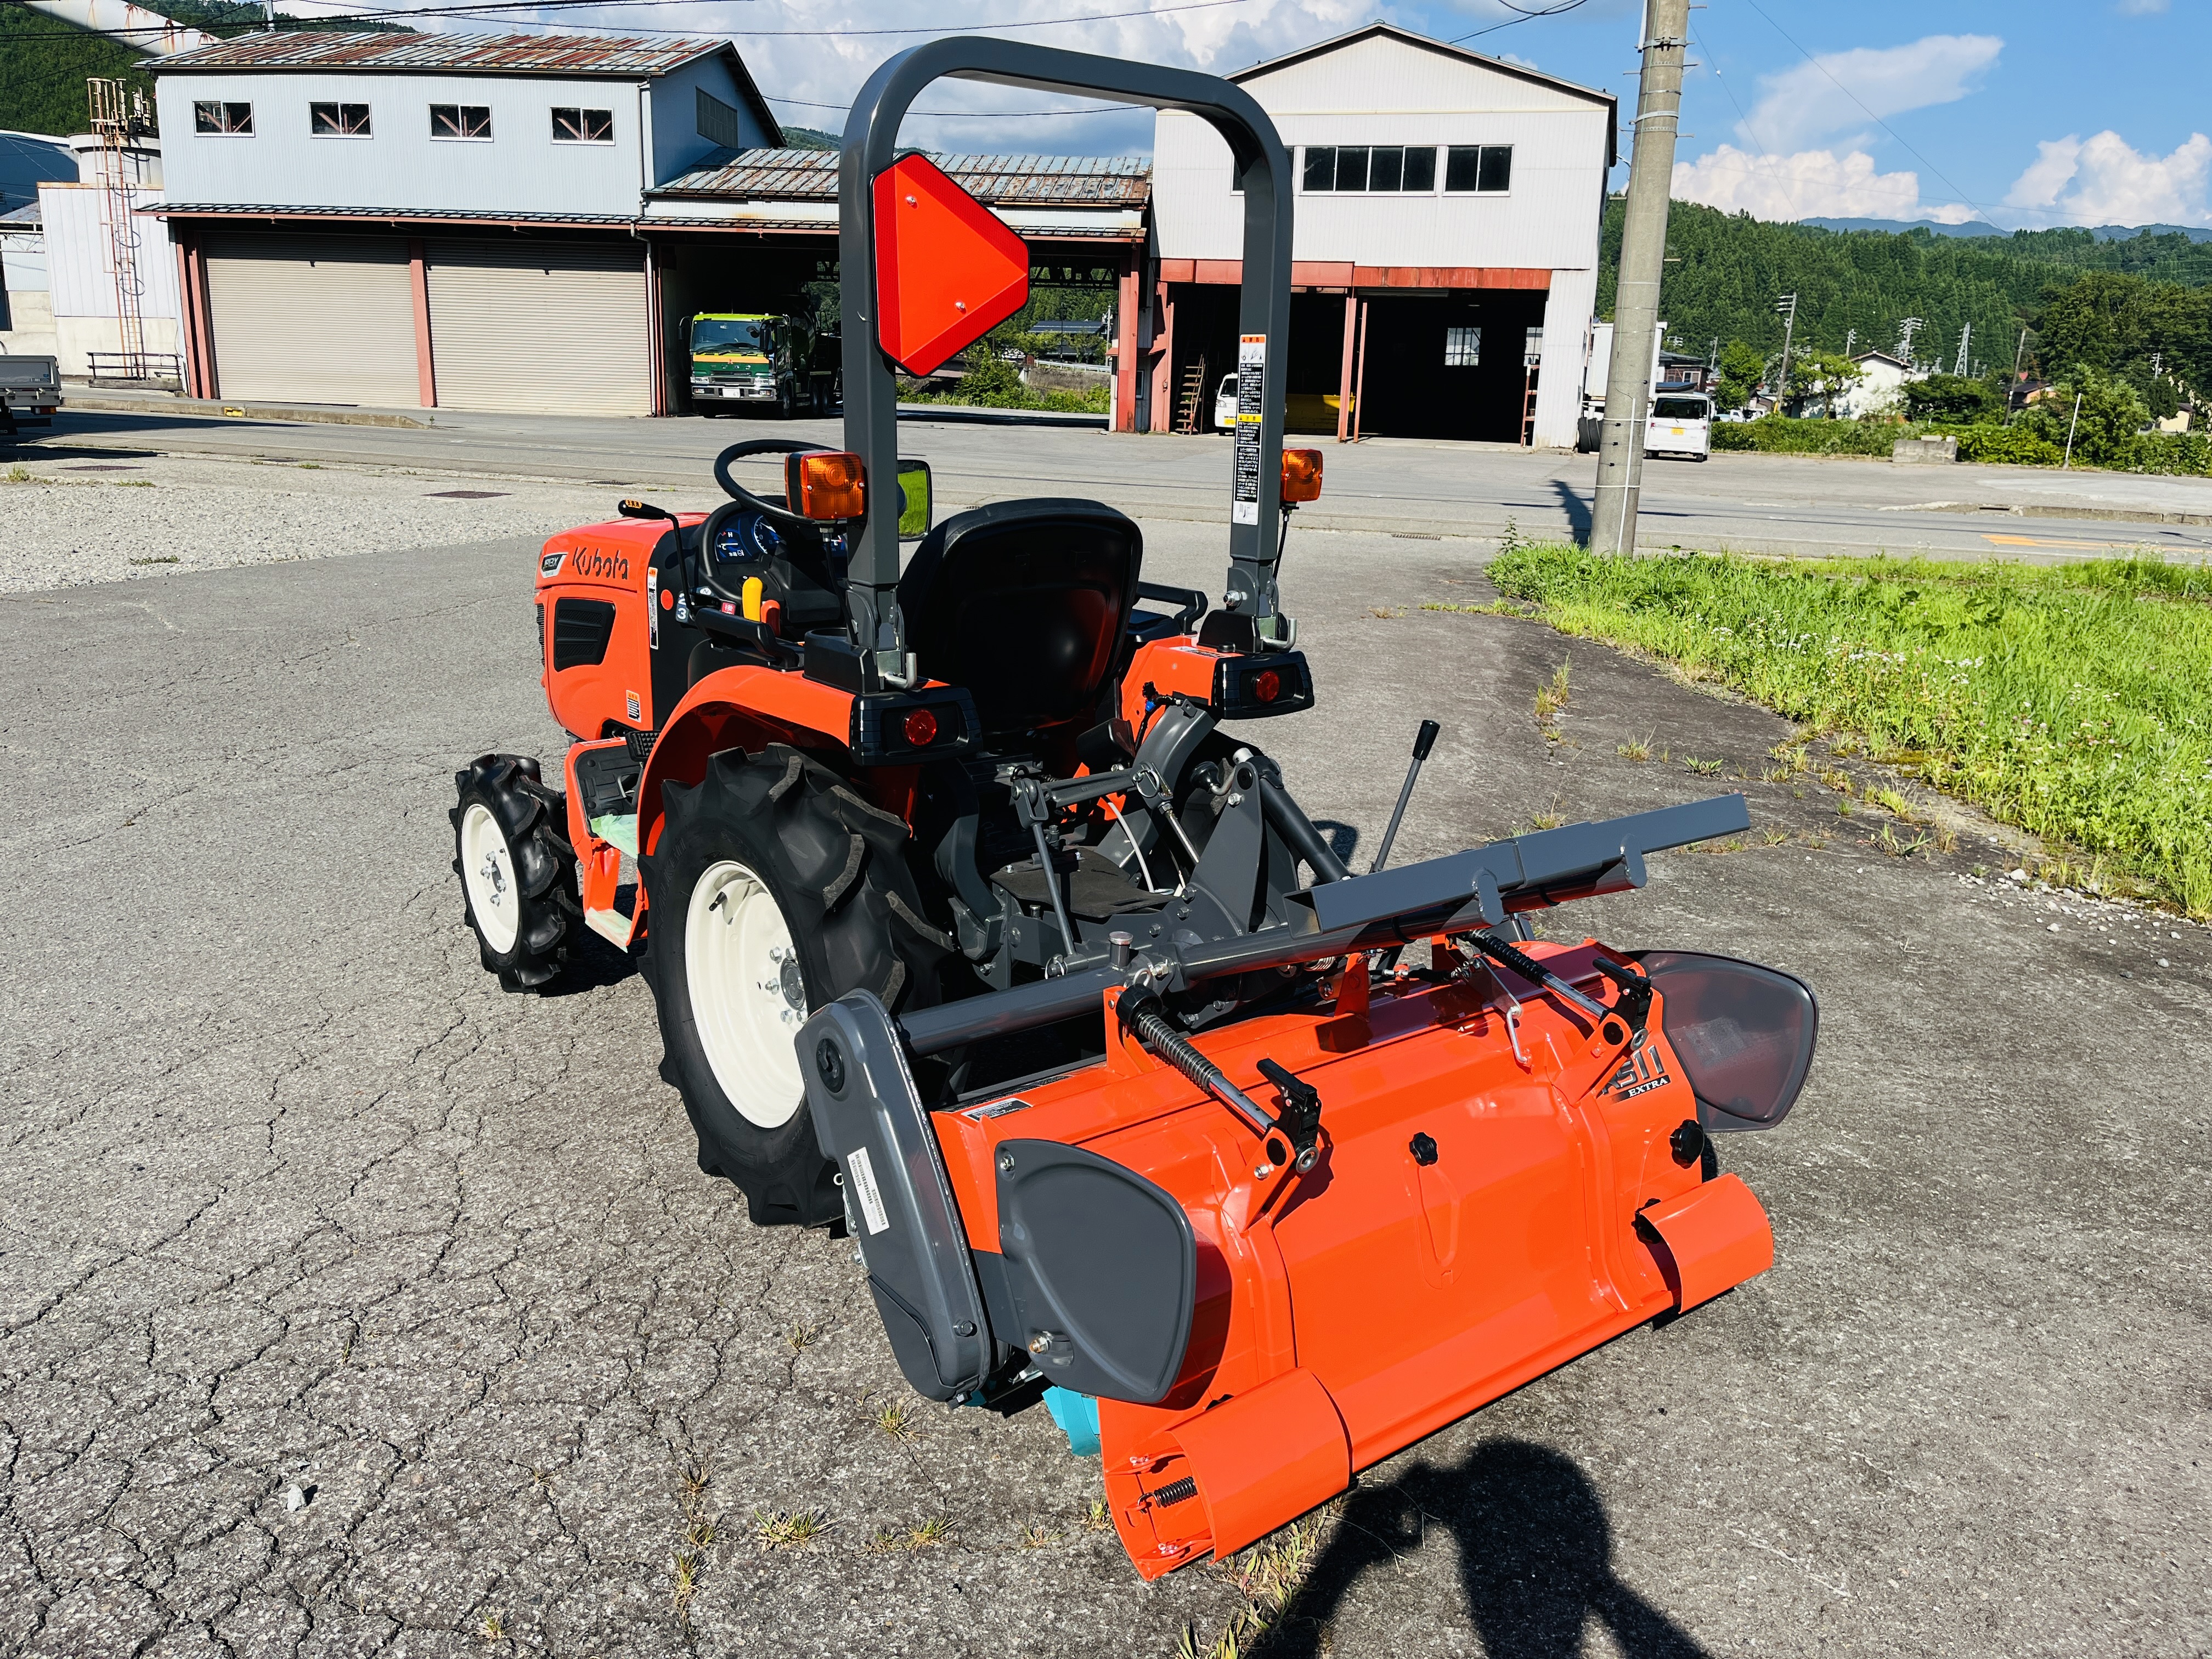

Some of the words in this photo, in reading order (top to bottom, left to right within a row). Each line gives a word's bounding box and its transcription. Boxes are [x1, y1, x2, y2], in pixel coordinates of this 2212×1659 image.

[572, 546, 628, 580] Kubota
[677, 607, 687, 619] 3
[1628, 1078, 1668, 1097] EXTRA
